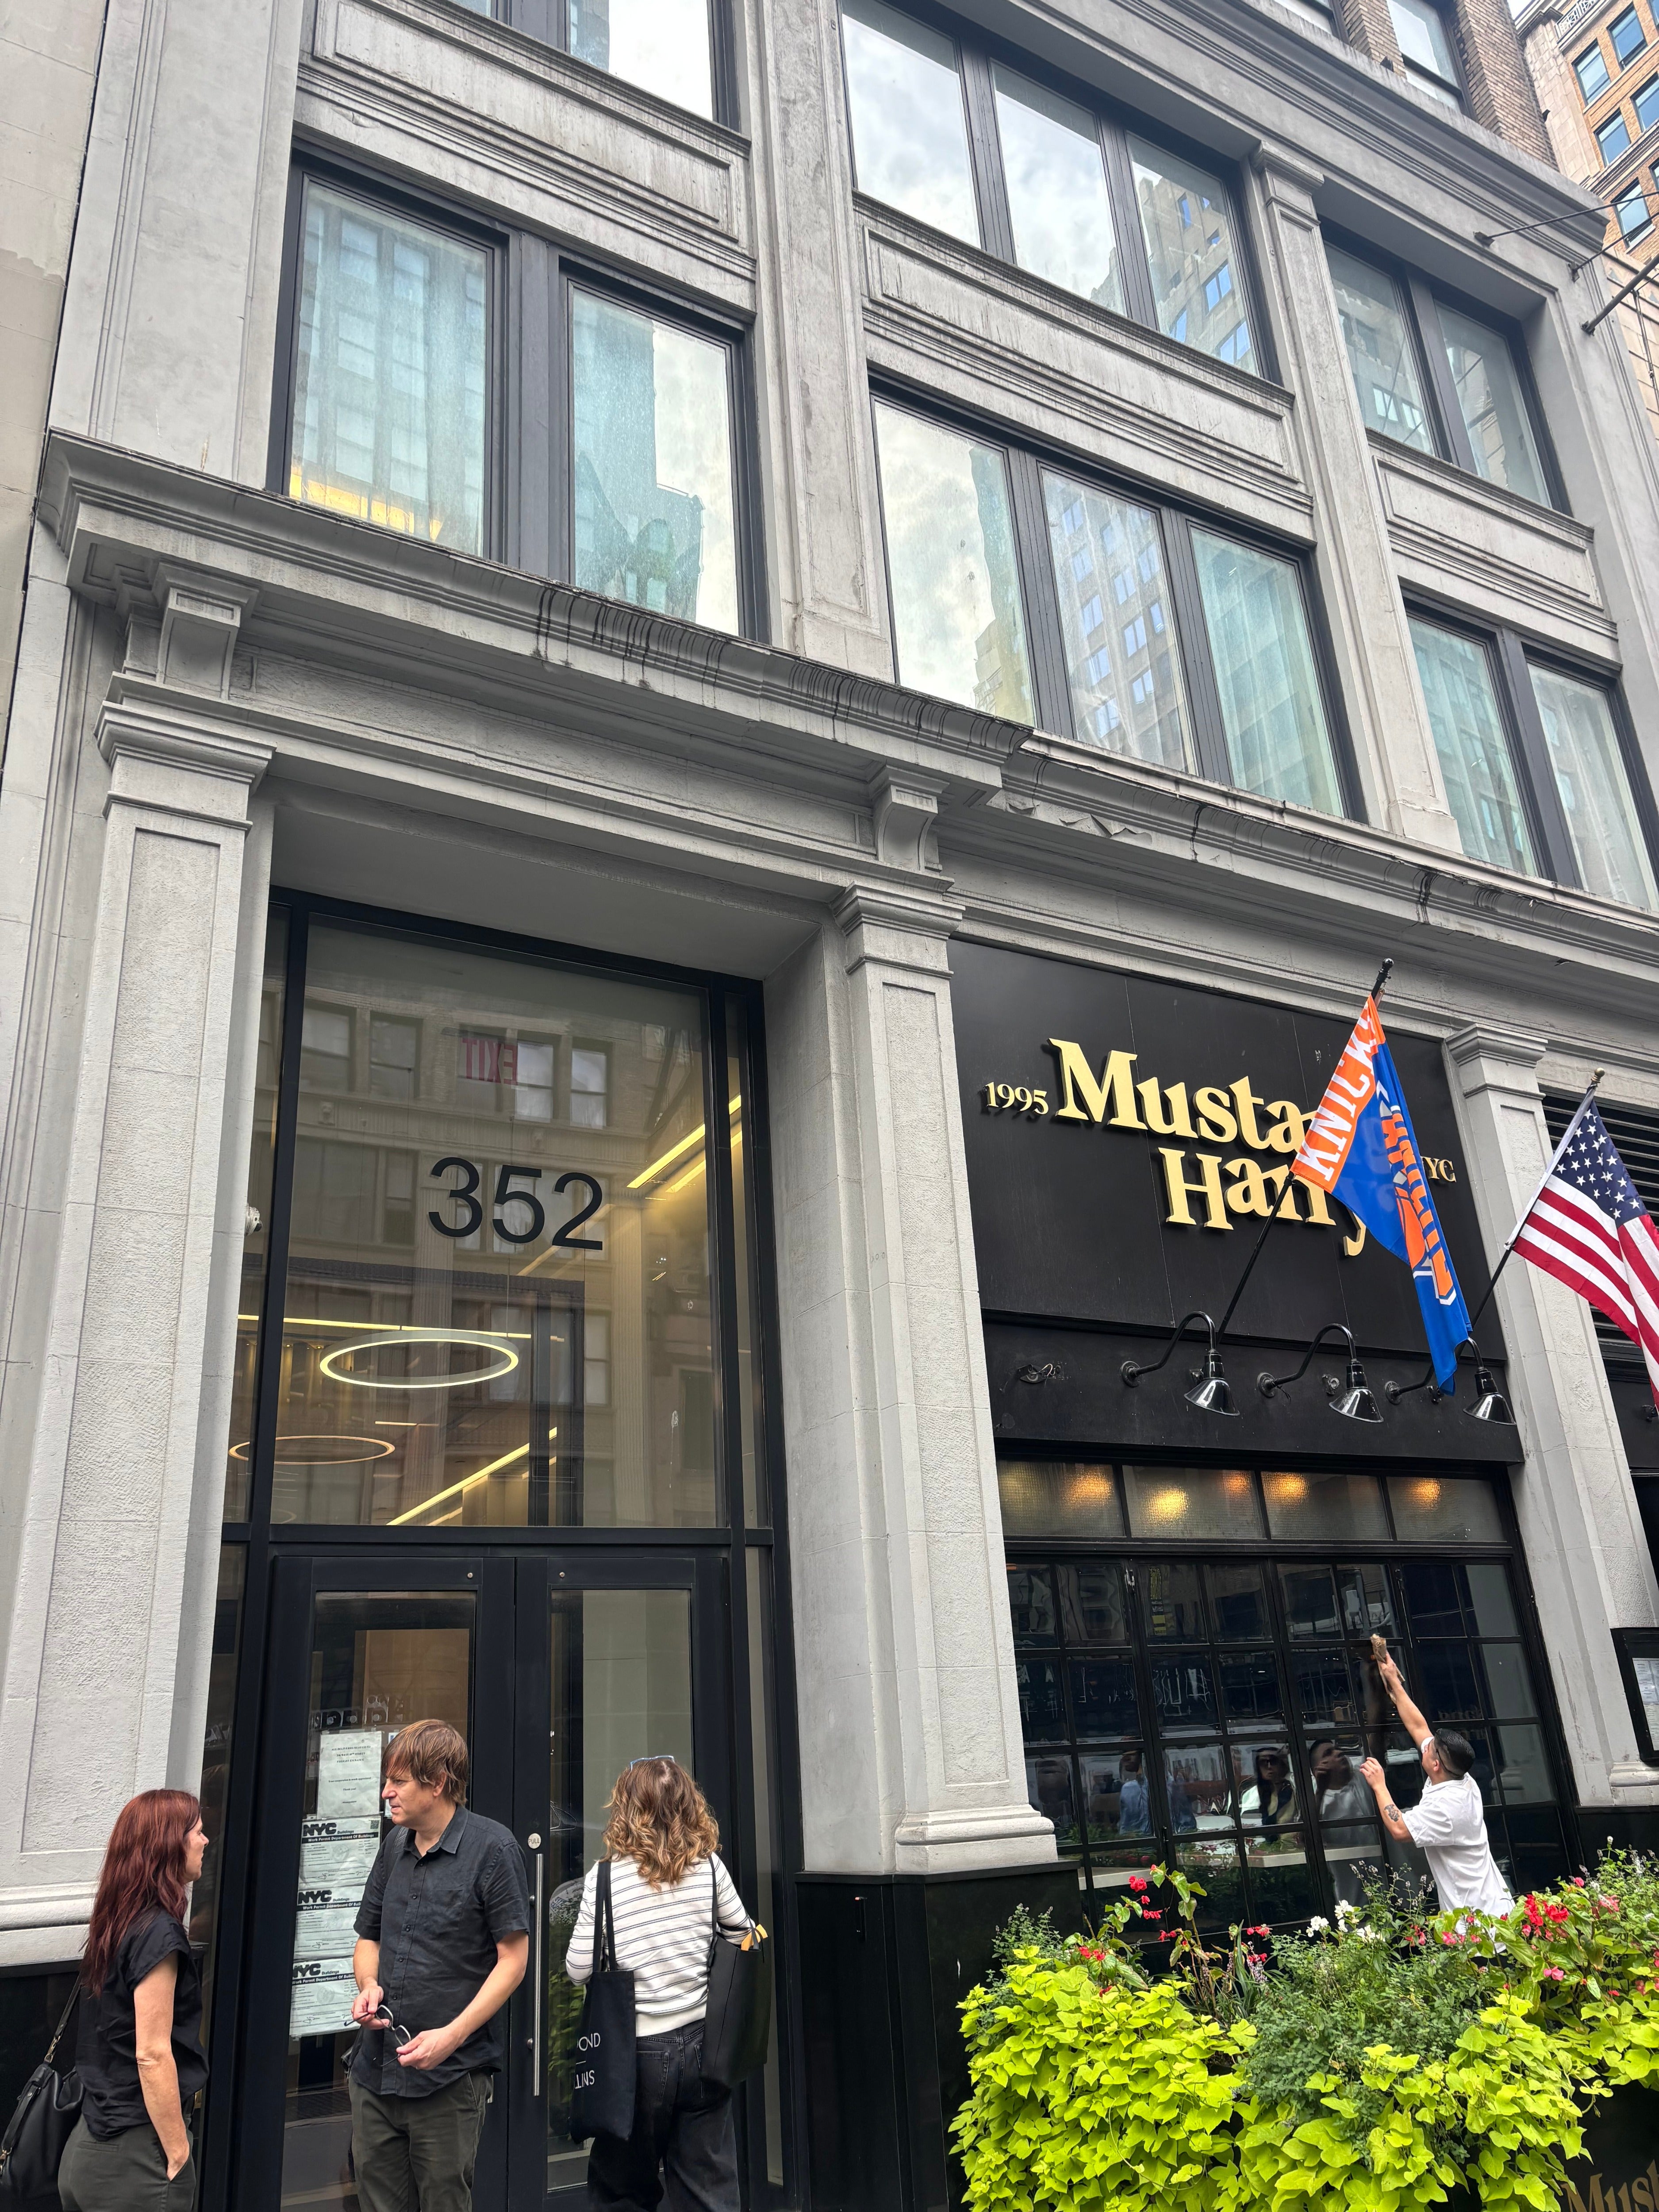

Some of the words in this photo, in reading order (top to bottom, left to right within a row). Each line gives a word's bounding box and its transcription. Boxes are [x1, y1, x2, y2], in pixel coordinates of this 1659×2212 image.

[984, 1082, 1049, 1114] 1995
[1048, 1037, 1317, 1153] Musta
[1420, 1156, 1457, 1183] YC
[428, 1156, 603, 1250] 352
[303, 1822, 337, 1836] NYC
[298, 1890, 332, 1904] NYC
[577, 2033, 600, 2051] OND
